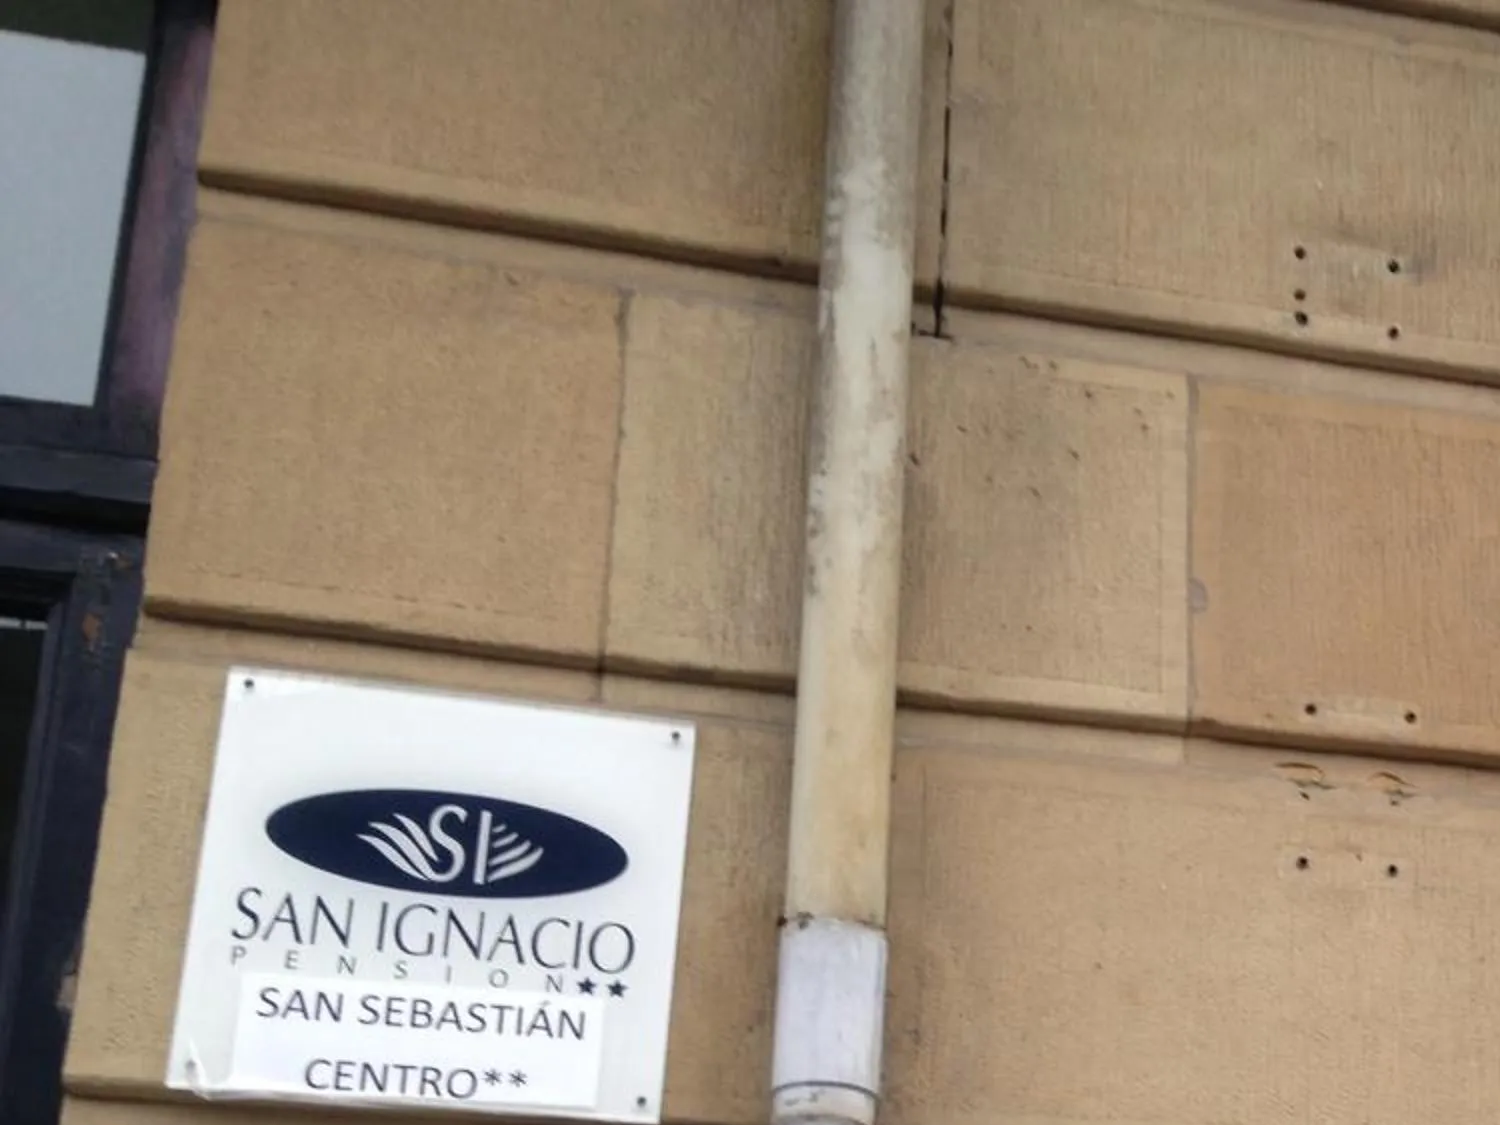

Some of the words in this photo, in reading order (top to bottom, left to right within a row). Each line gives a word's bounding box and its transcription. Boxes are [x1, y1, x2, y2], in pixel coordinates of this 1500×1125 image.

[231, 886, 355, 950] SAN
[375, 900, 636, 975] IGNACIO
[230, 944, 564, 995] PENSION
[255, 985, 344, 1024] SAN
[356, 994, 588, 1042] SEBASTIÁN
